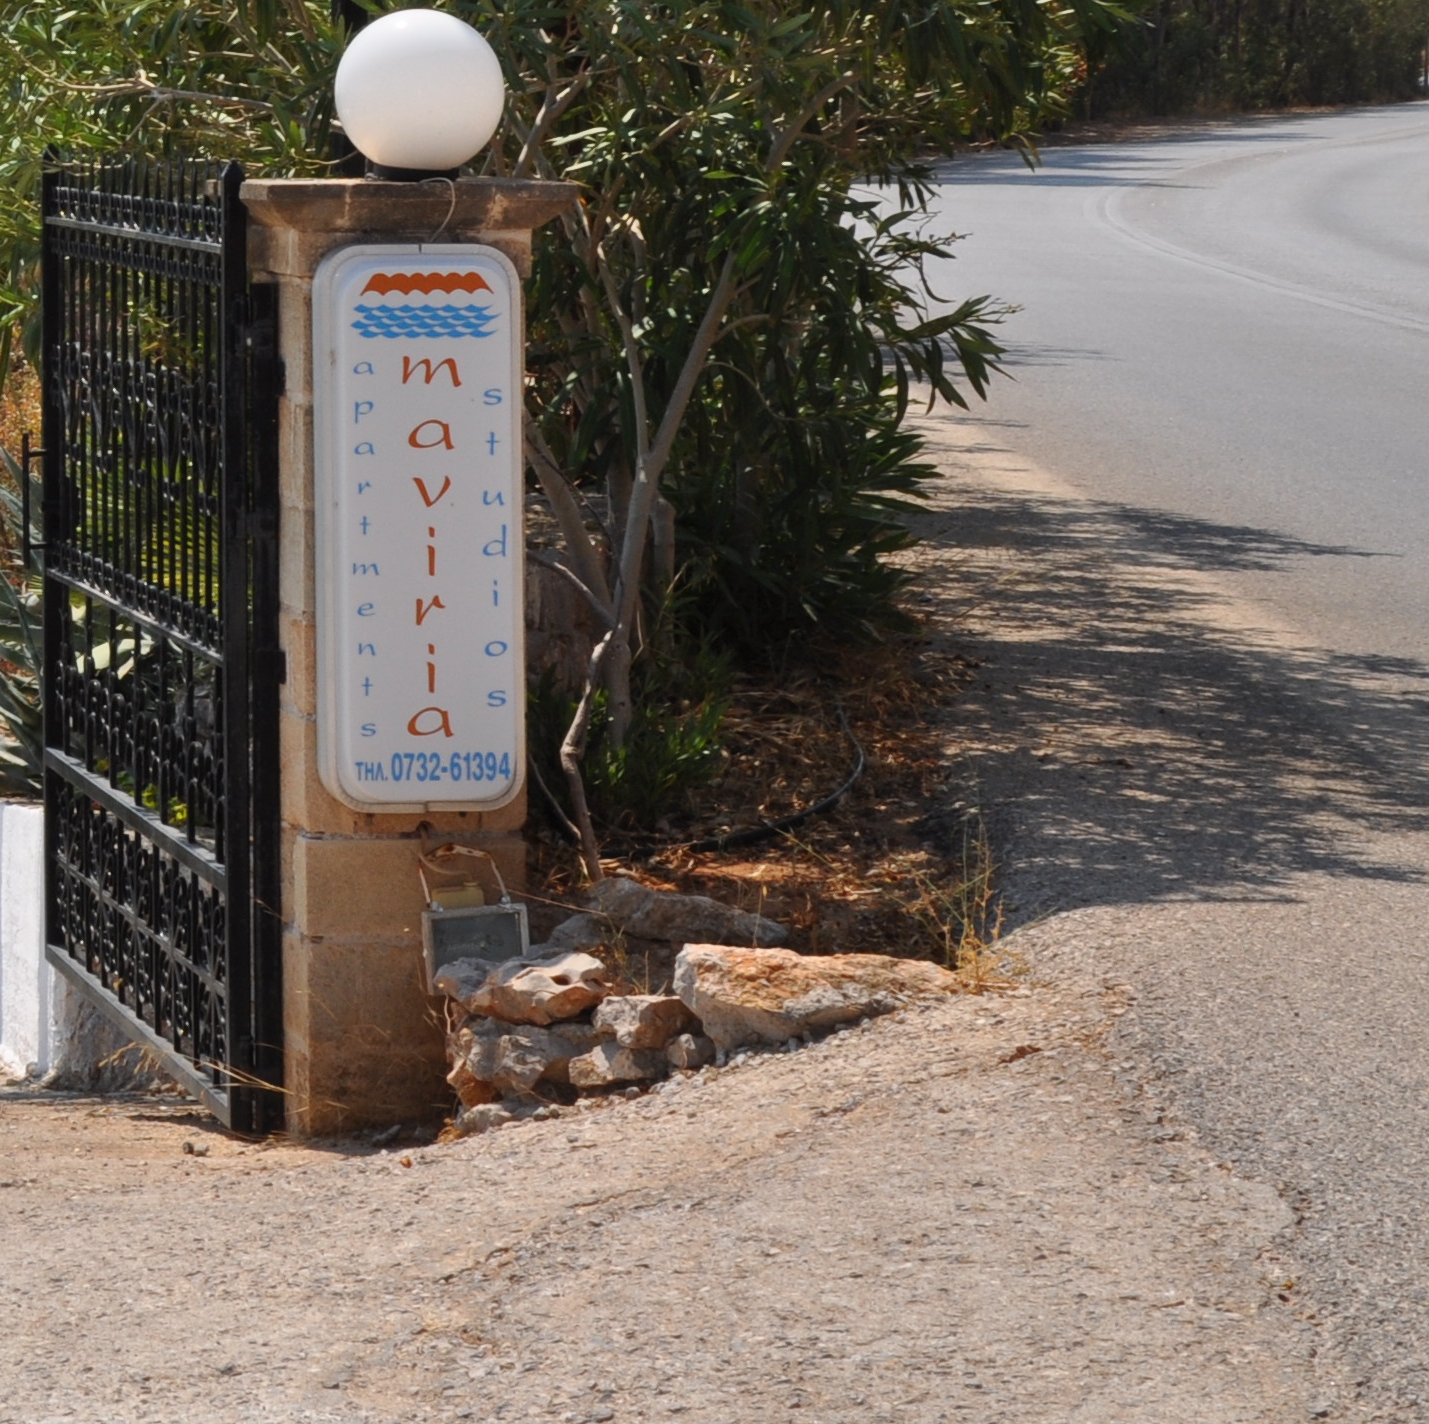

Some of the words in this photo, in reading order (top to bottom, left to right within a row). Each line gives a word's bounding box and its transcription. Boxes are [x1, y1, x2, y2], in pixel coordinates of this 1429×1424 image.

[352, 359, 380, 738] apartments
[401, 354, 463, 739] maviria
[482, 386, 508, 708] studios
[391, 751, 511, 782] 0732-61394
